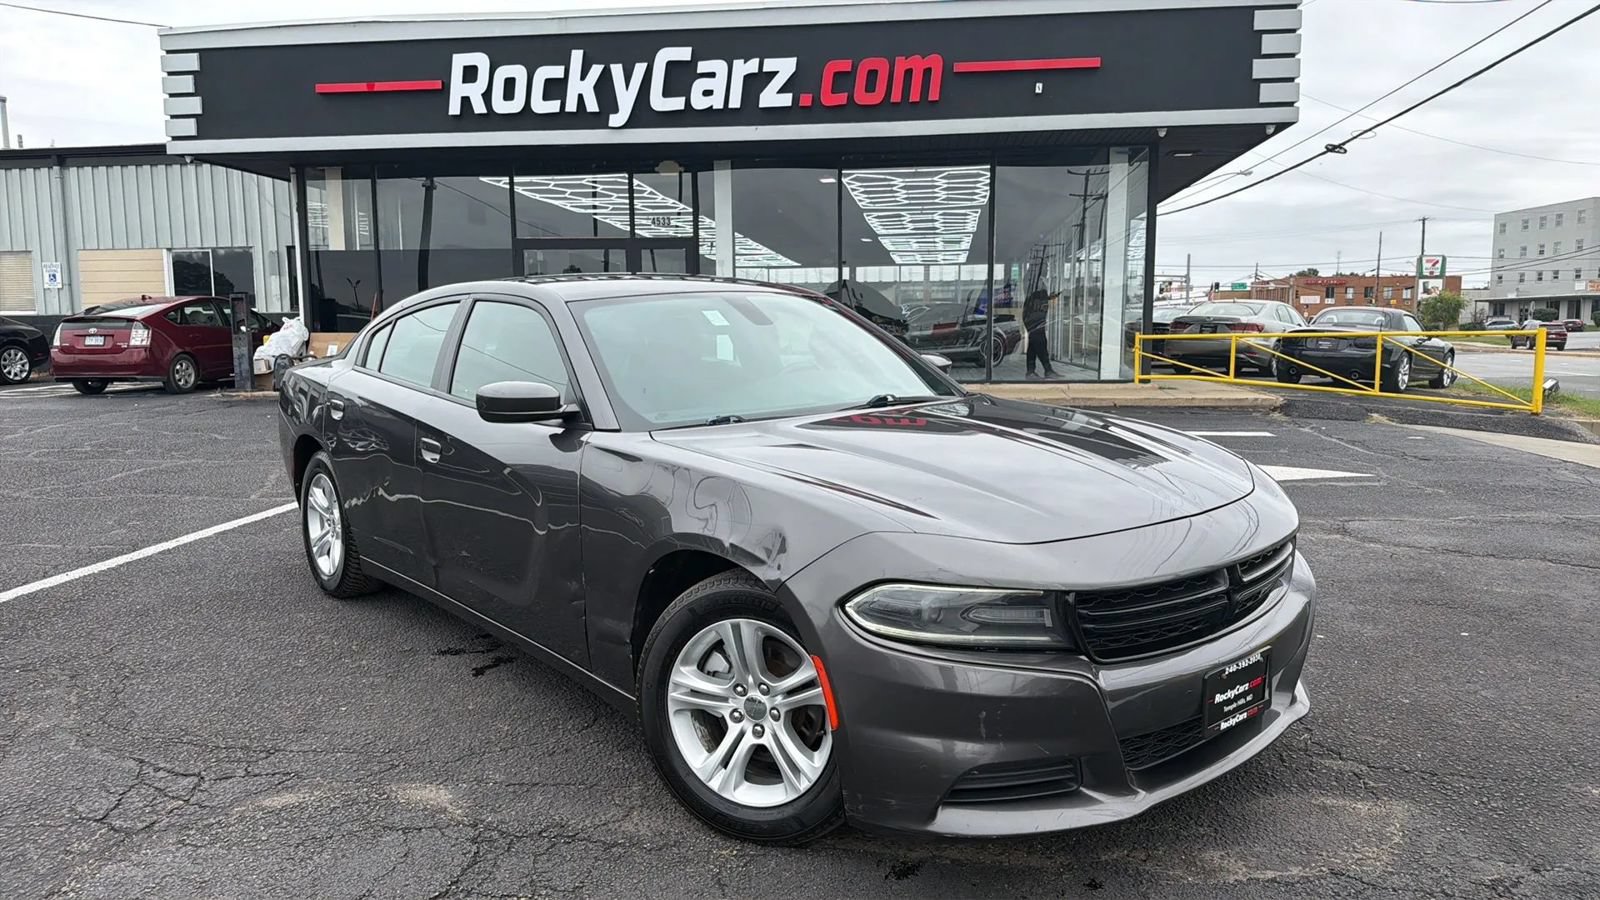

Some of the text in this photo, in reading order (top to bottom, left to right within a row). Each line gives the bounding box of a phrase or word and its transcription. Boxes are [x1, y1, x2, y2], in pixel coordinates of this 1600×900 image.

[448, 46, 944, 128] RockyCarz.com
[651, 216, 671, 226] 4533
[1214, 676, 1262, 704] RockyCarz.com
[1220, 706, 1258, 730] RockyCarz.com
